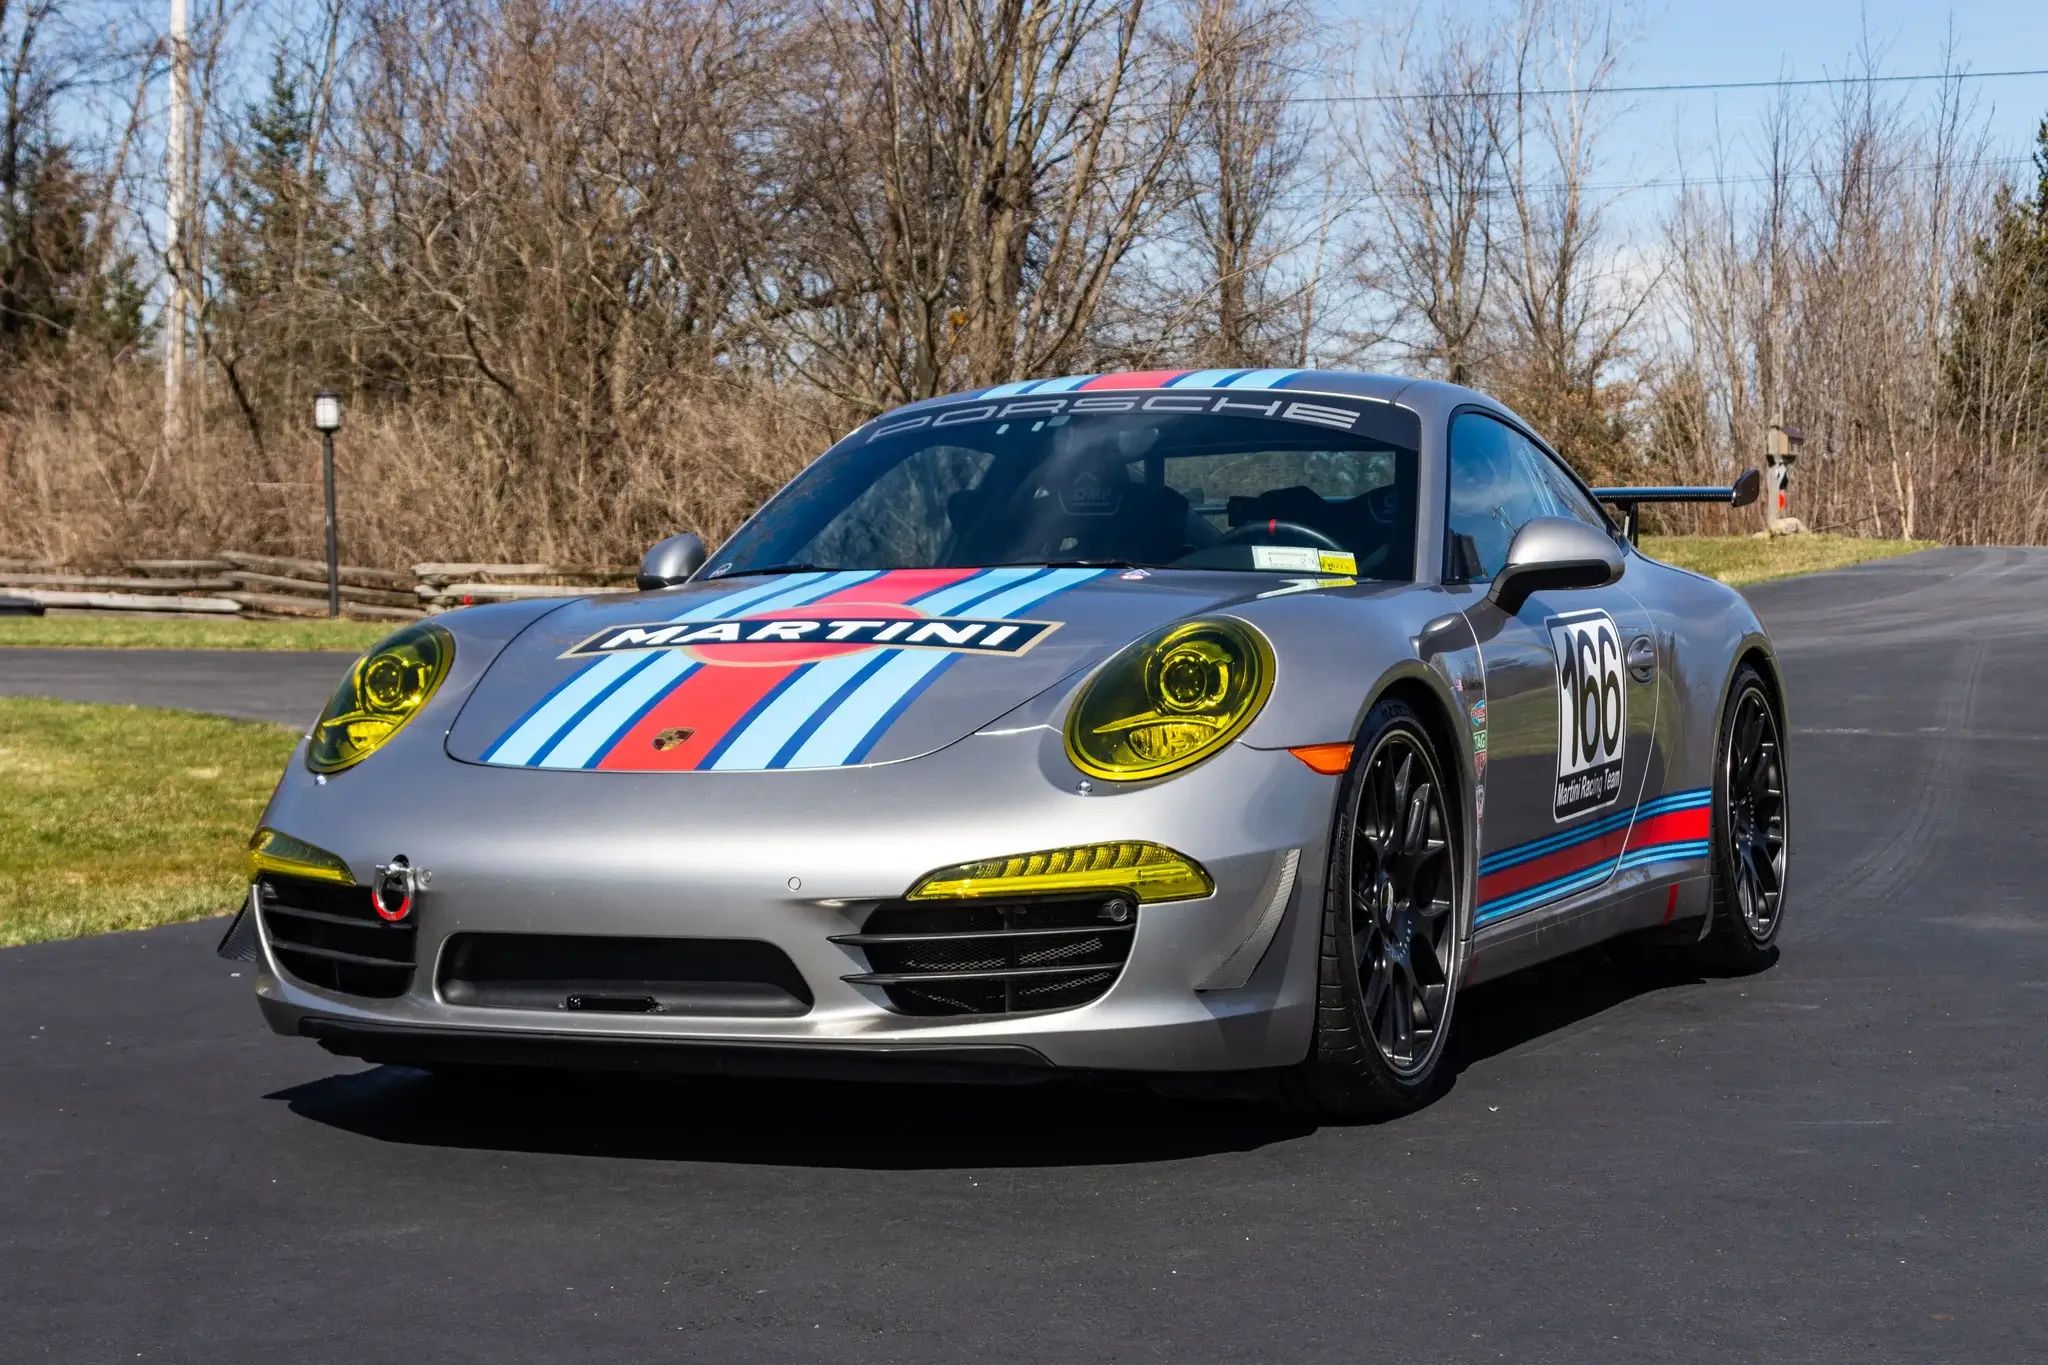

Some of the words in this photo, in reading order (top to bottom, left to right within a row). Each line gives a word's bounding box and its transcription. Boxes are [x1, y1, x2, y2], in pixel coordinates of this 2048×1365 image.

[865, 396, 1361, 443] PORSCHE
[602, 620, 1021, 647] MARTINI
[1562, 625, 1621, 768] 166
[1556, 779, 1581, 807] Martini
[1580, 772, 1604, 800] Racing
[1604, 768, 1620, 791] Team
